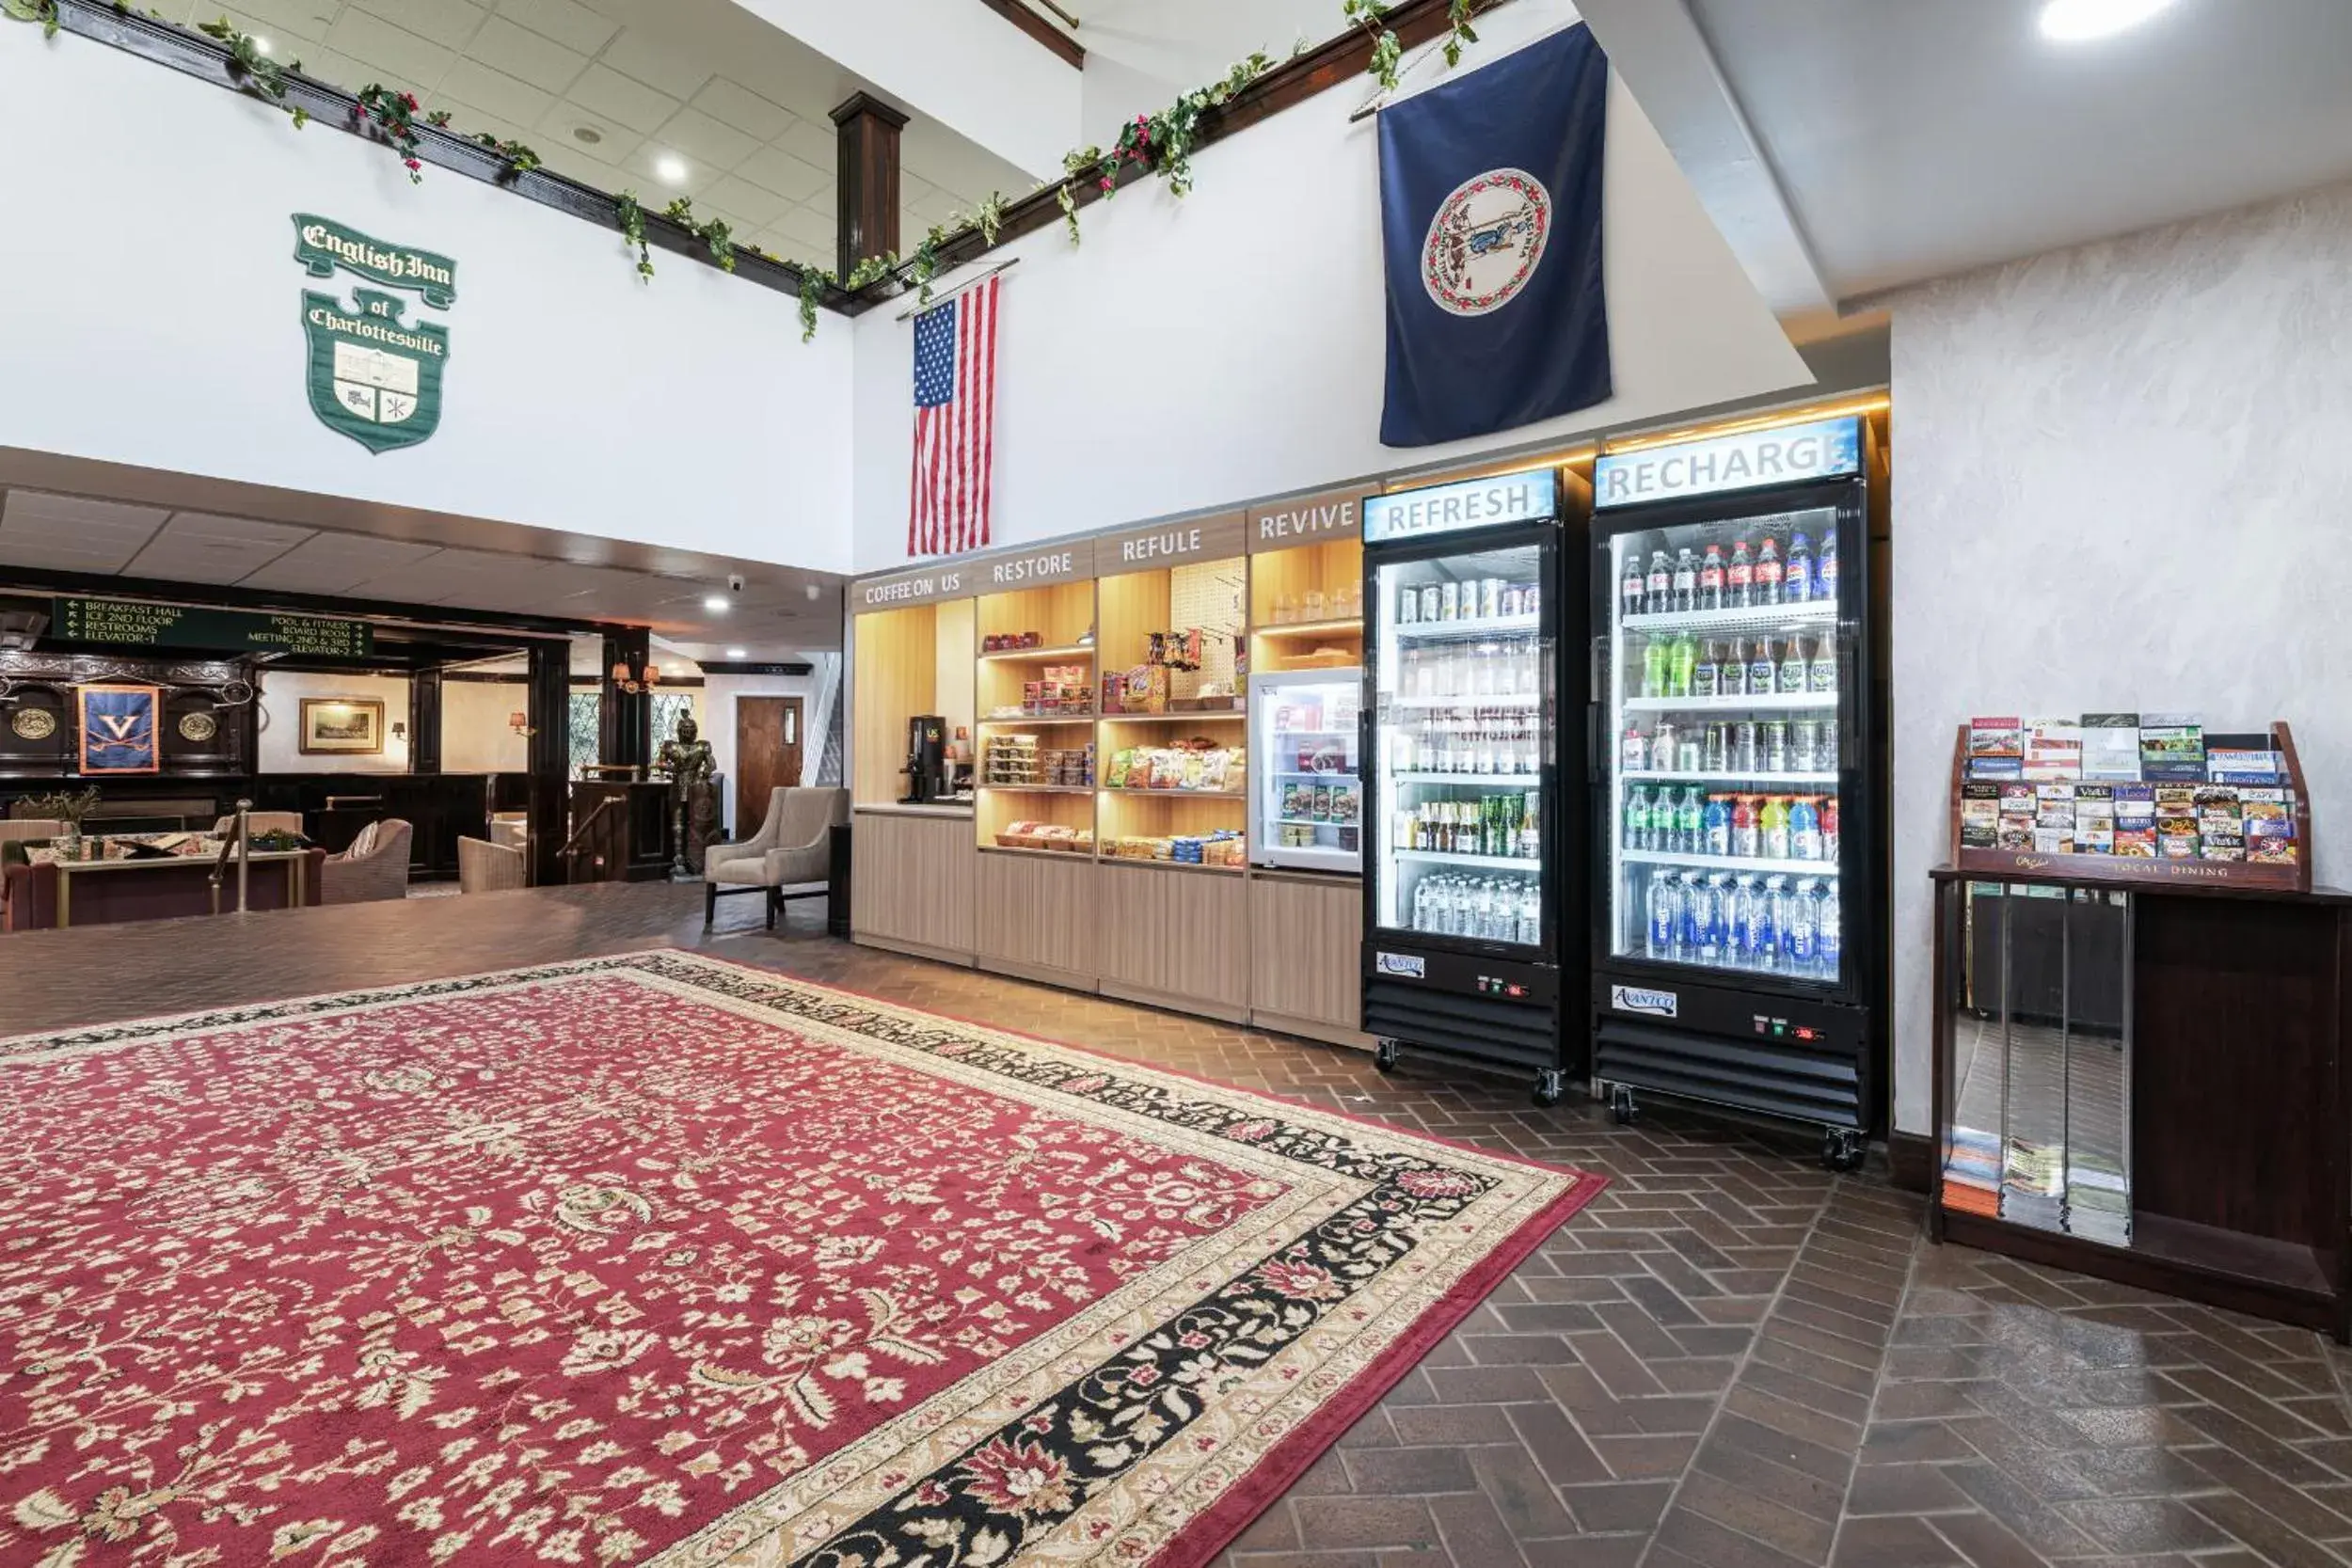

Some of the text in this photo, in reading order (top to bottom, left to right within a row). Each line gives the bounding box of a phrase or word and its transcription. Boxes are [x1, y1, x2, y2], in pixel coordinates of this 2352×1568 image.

[302, 224, 452, 285] English Inn
[371, 300, 389, 317] of
[309, 308, 442, 356] Charlottesville
[1388, 483, 1529, 531] REFRESH
[1261, 500, 1355, 540] REVIVE
[1122, 528, 1201, 562] REFULE
[993, 552, 1072, 583] RESTORE
[865, 573, 961, 604] COFFEE ON US
[85, 601, 183, 618] BREAKFAST HALL
[85, 610, 174, 626] ICE 2ND FLOOR
[85, 621, 158, 635] RESTROOMS
[271, 615, 298, 626] POOL
[312, 620, 350, 629] FITNESS
[247, 631, 294, 643] MEETING
[295, 635, 318, 645] 2ND
[283, 626, 350, 639] BOARD ROOM
[2171, 864, 2228, 878] DINING
